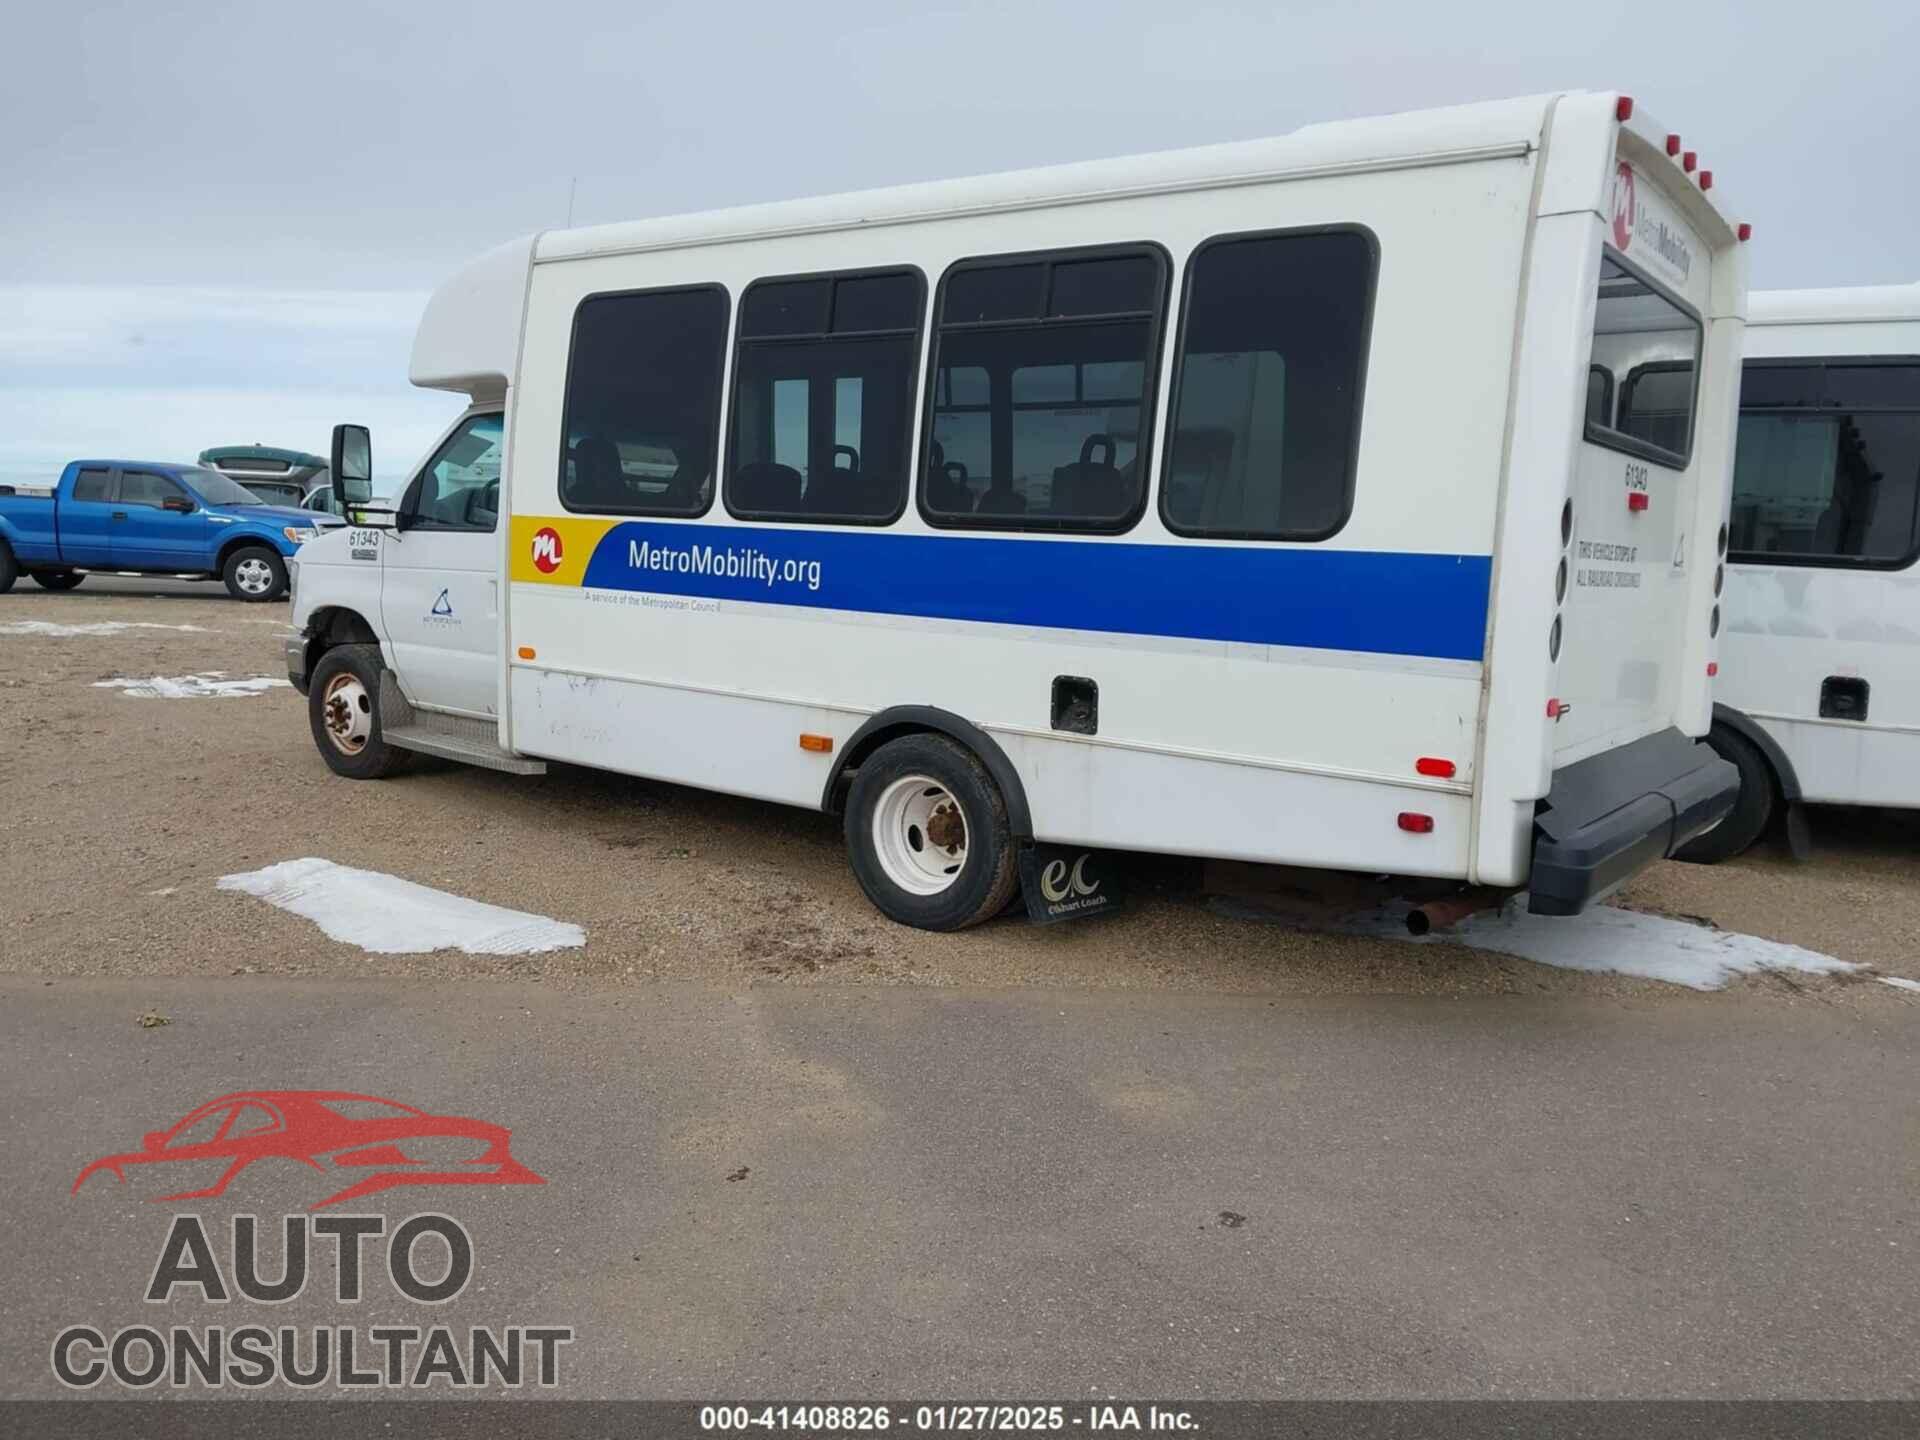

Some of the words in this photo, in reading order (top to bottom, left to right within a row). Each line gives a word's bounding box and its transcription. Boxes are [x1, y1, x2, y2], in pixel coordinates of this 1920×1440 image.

[1624, 463, 1648, 491] 61343
[350, 530, 379, 546] 61343
[628, 539, 822, 591] MetroMobility.org
[592, 594, 617, 604] service
[619, 594, 628, 605] of
[628, 595, 640, 606] the
[641, 596, 690, 610] Metropolitan
[690, 600, 721, 613] Council
